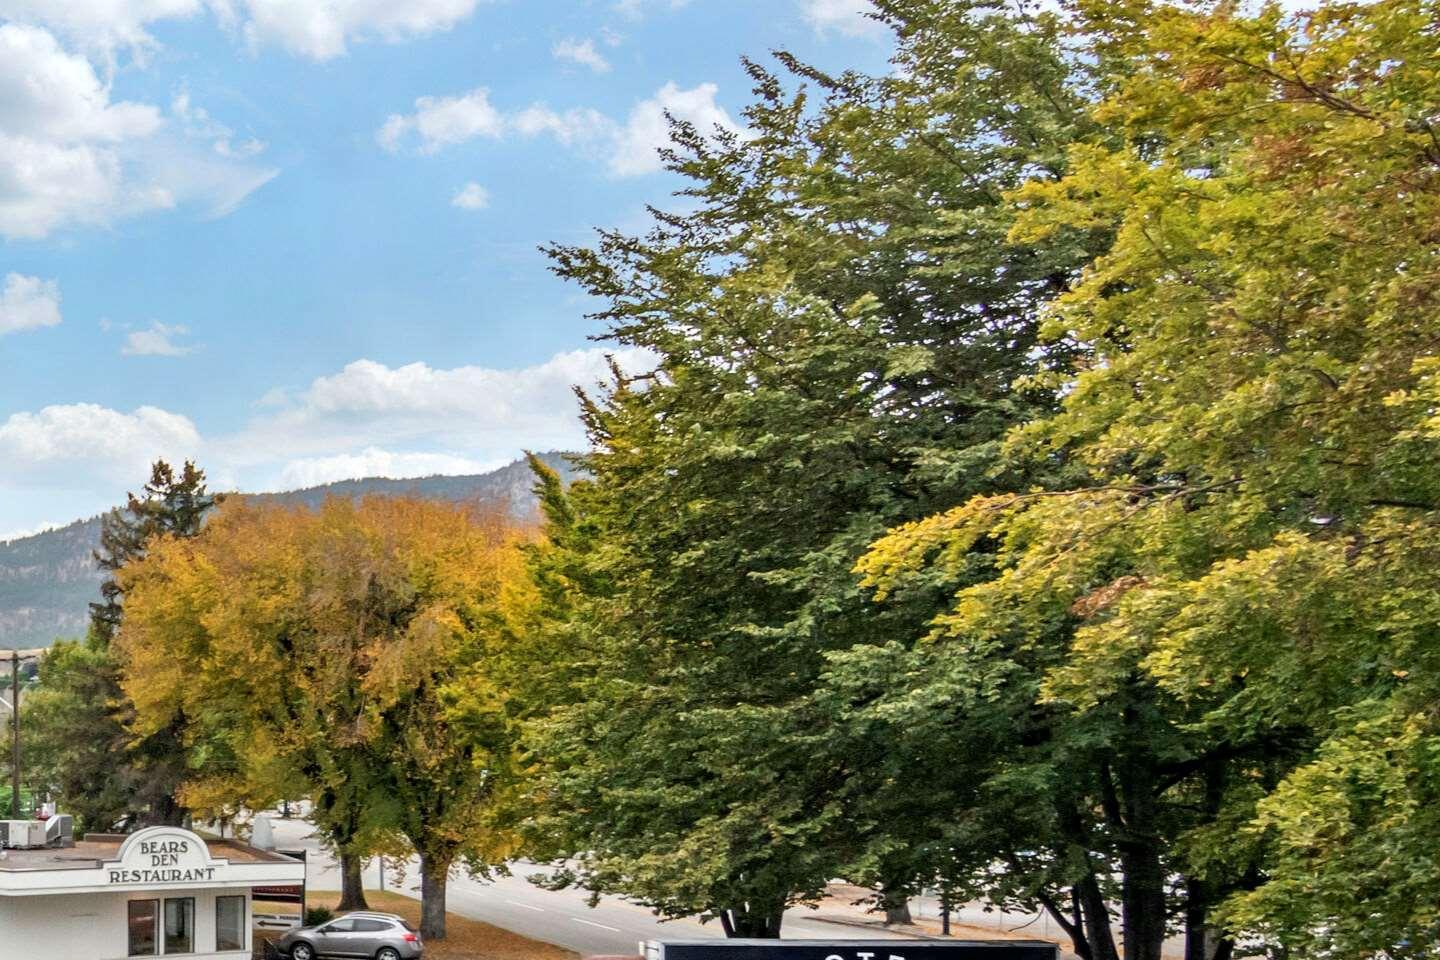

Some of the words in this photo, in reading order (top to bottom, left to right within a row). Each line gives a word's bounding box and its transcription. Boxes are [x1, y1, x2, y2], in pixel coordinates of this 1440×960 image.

[140, 841, 188, 854] BEARS
[151, 854, 178, 867] DEN
[110, 868, 215, 883] RESTAURANT
